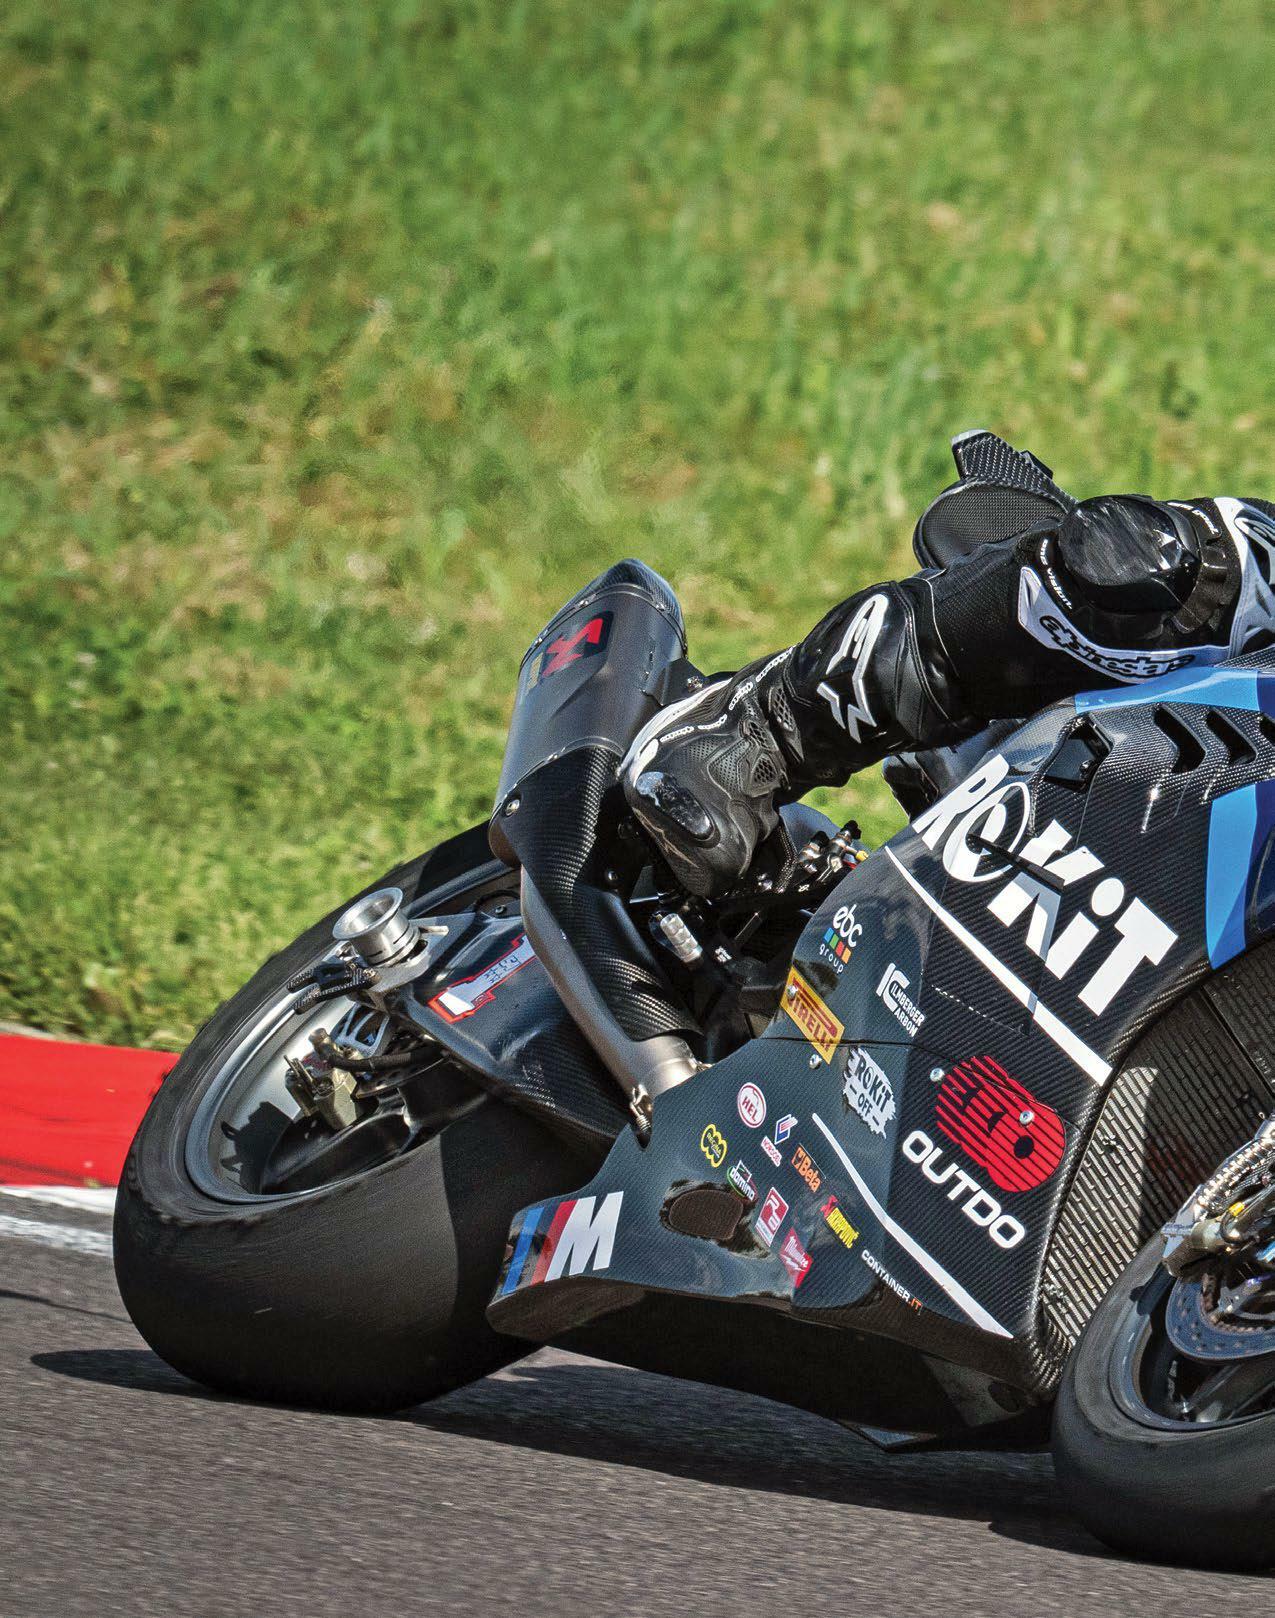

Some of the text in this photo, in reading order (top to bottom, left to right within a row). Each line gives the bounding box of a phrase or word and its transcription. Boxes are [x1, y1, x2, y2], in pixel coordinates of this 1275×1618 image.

[912, 753, 1179, 1017] ROKiT
[832, 904, 862, 948] ebc
[819, 943, 844, 974] group
[742, 1096, 758, 1121] HEL
[858, 1093, 873, 1117] OFF
[729, 1167, 756, 1201] domino
[799, 1155, 821, 1192] Beta
[902, 1130, 1025, 1249] OUTDO
[544, 1191, 624, 1282] M
